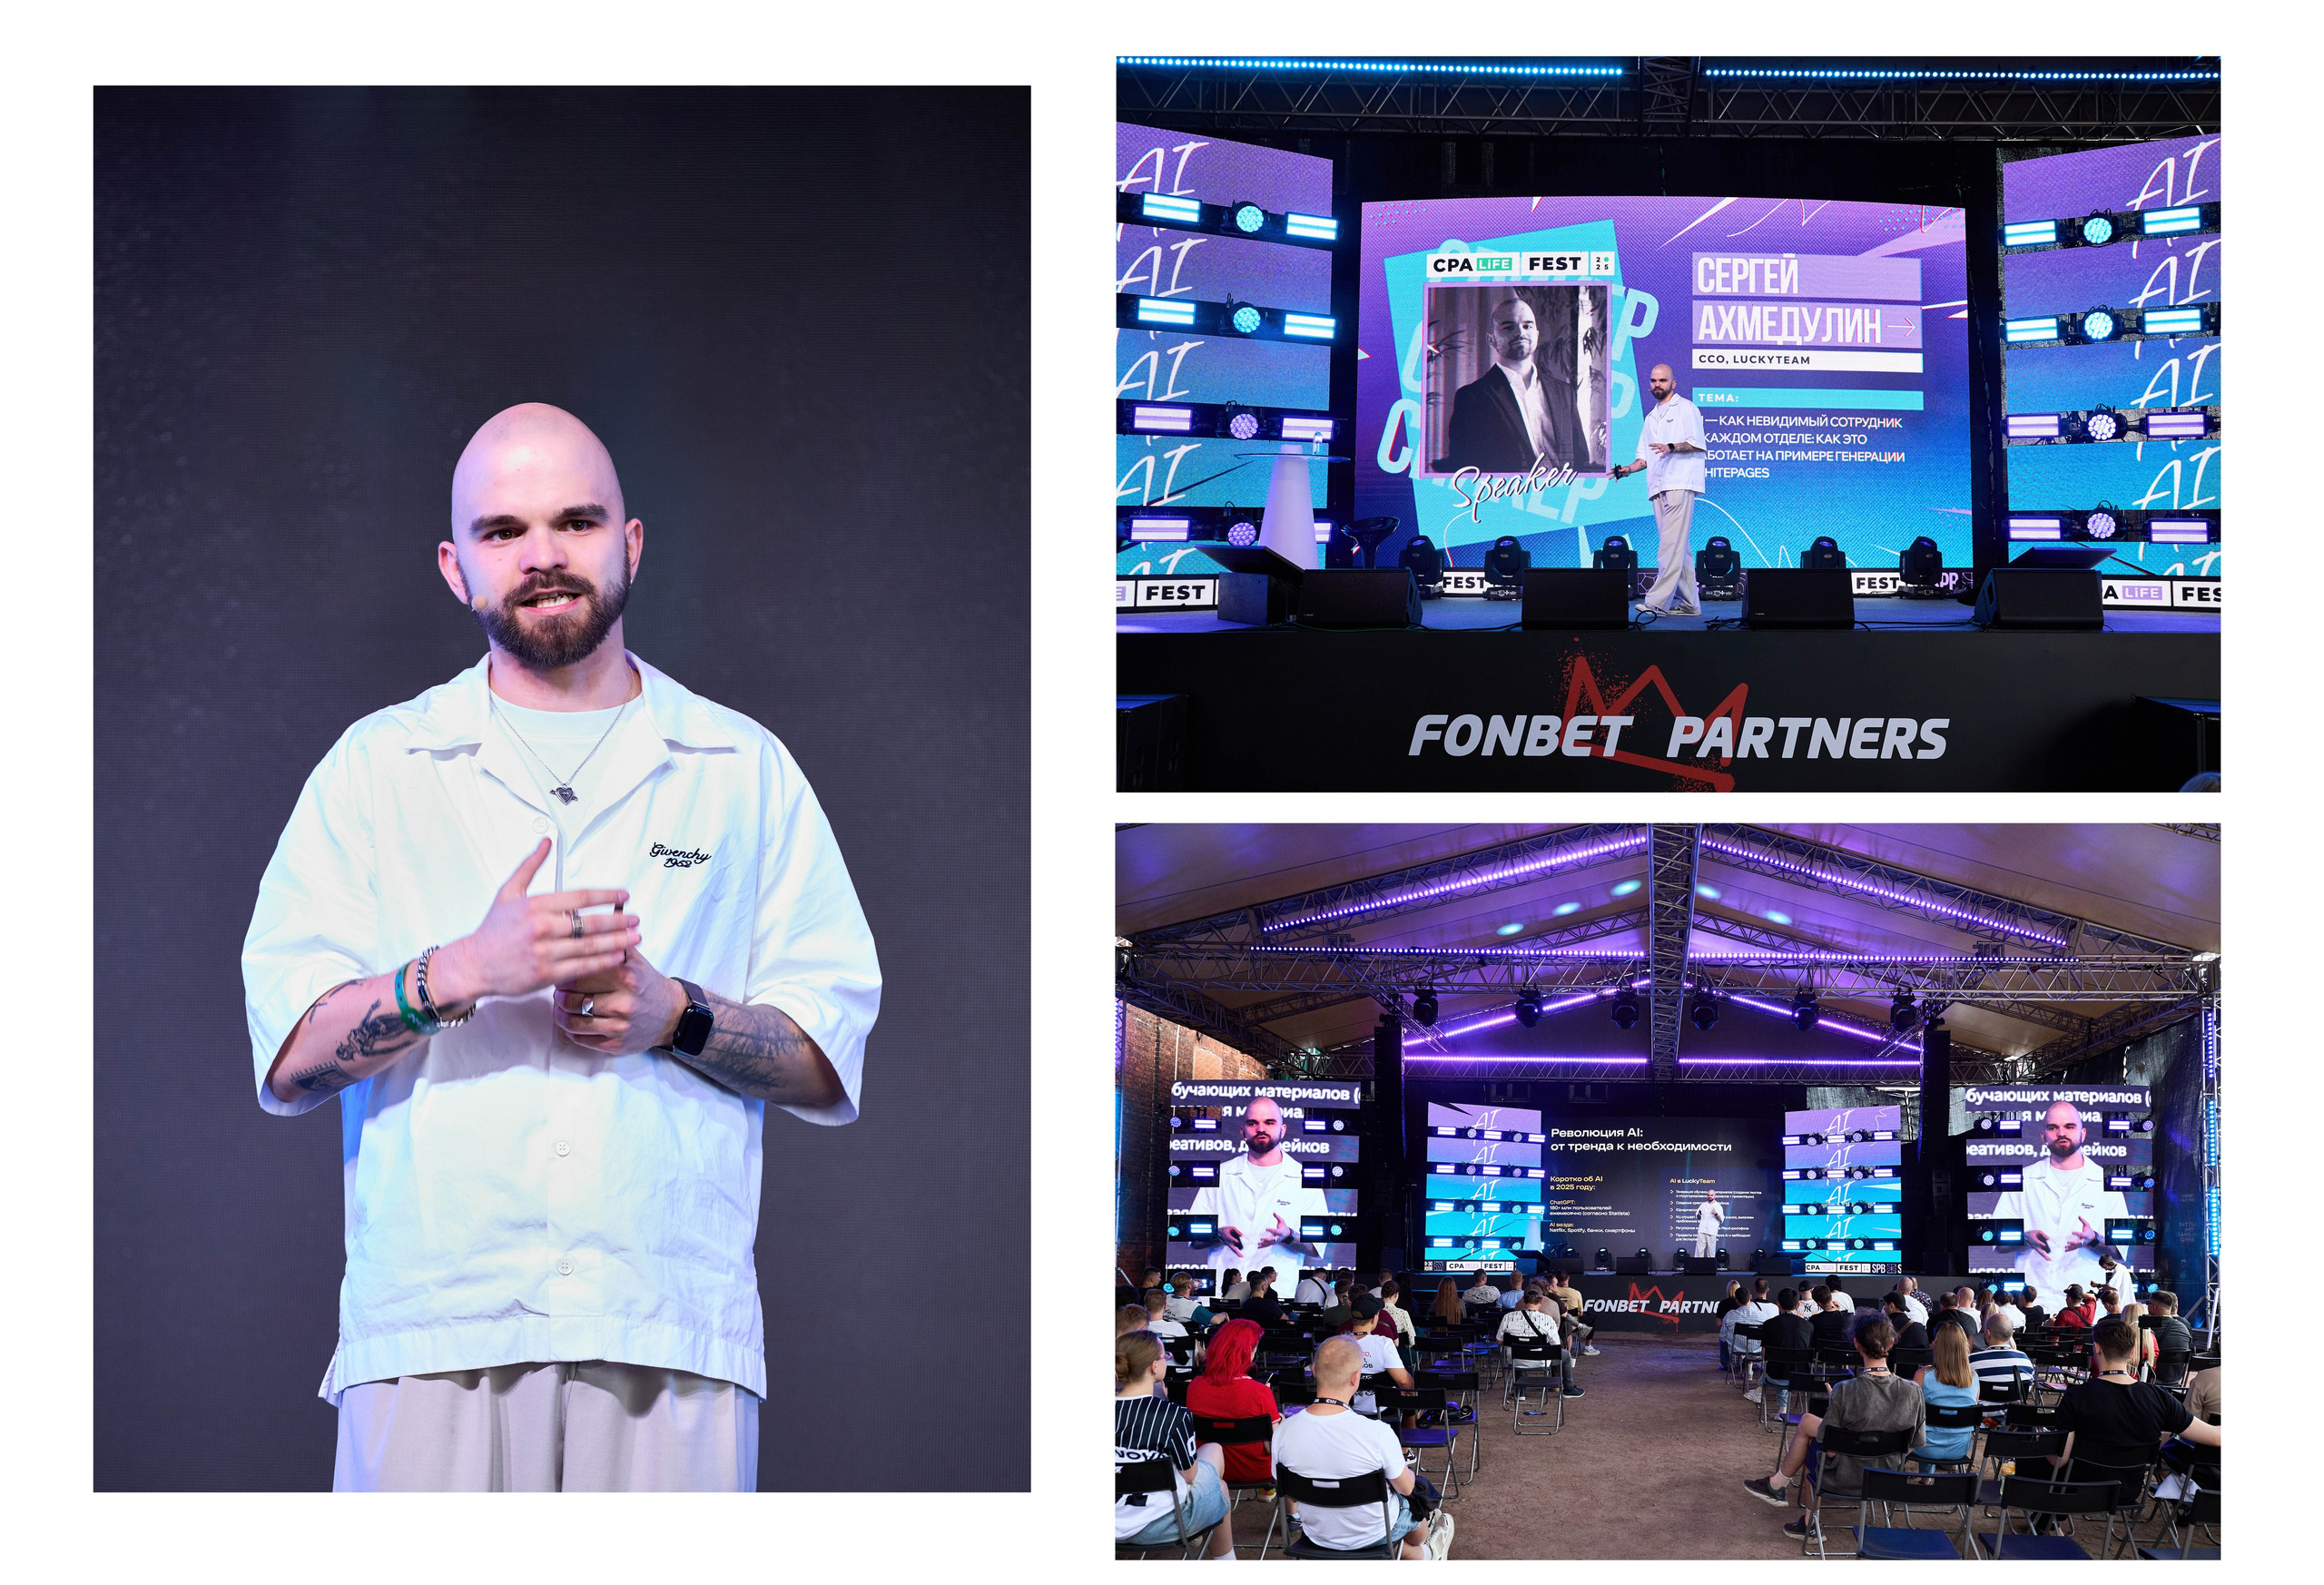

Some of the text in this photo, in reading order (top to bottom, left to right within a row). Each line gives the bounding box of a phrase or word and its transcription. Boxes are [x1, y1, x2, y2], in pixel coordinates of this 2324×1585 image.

[1433, 258, 1473, 272] CPA
[1529, 256, 1581, 271] FEST
[1698, 253, 1798, 294] СЕРГЕЙ
[1698, 305, 1882, 345] АХМЕДУЛИН
[1699, 354, 1810, 365] CCO, LUCKYTEAM
[1699, 393, 1739, 403] ТЕМА:
[1718, 415, 1745, 427] КАК
[1747, 414, 1828, 428] НЕВИДИМЫЙ
[1829, 416, 1904, 429] СОТРУДНИК
[1763, 433, 1815, 445] ОТДЕЛЕ:
[1816, 433, 1841, 445] КАК
[1842, 434, 1867, 445] ЭТО
[1705, 449, 1905, 464] БОТАЕТ НА ПРИМЕРЕ ГЕНЕРАЦИИ
[1704, 467, 1770, 478] HITEPAGES
[1452, 452, 1578, 524] Speaker
[1443, 576, 1485, 589] FEST
[1856, 576, 1899, 589] FEST
[1146, 585, 1206, 601] FEST
[2181, 586, 2221, 602] FES
[1408, 714, 1950, 760] FONBET PARTNERS
[649, 842, 712, 865] Givenchy
[1171, 1081, 1350, 1101] бучающих материалов
[1965, 1088, 2142, 1106] бучающих материалов
[1551, 1127, 1644, 1138] Революция AI:
[1551, 1141, 1732, 1153] от тренда к необходимости
[1550, 1176, 1582, 1184] Коротко
[1583, 1299, 1649, 1313] FONBET
